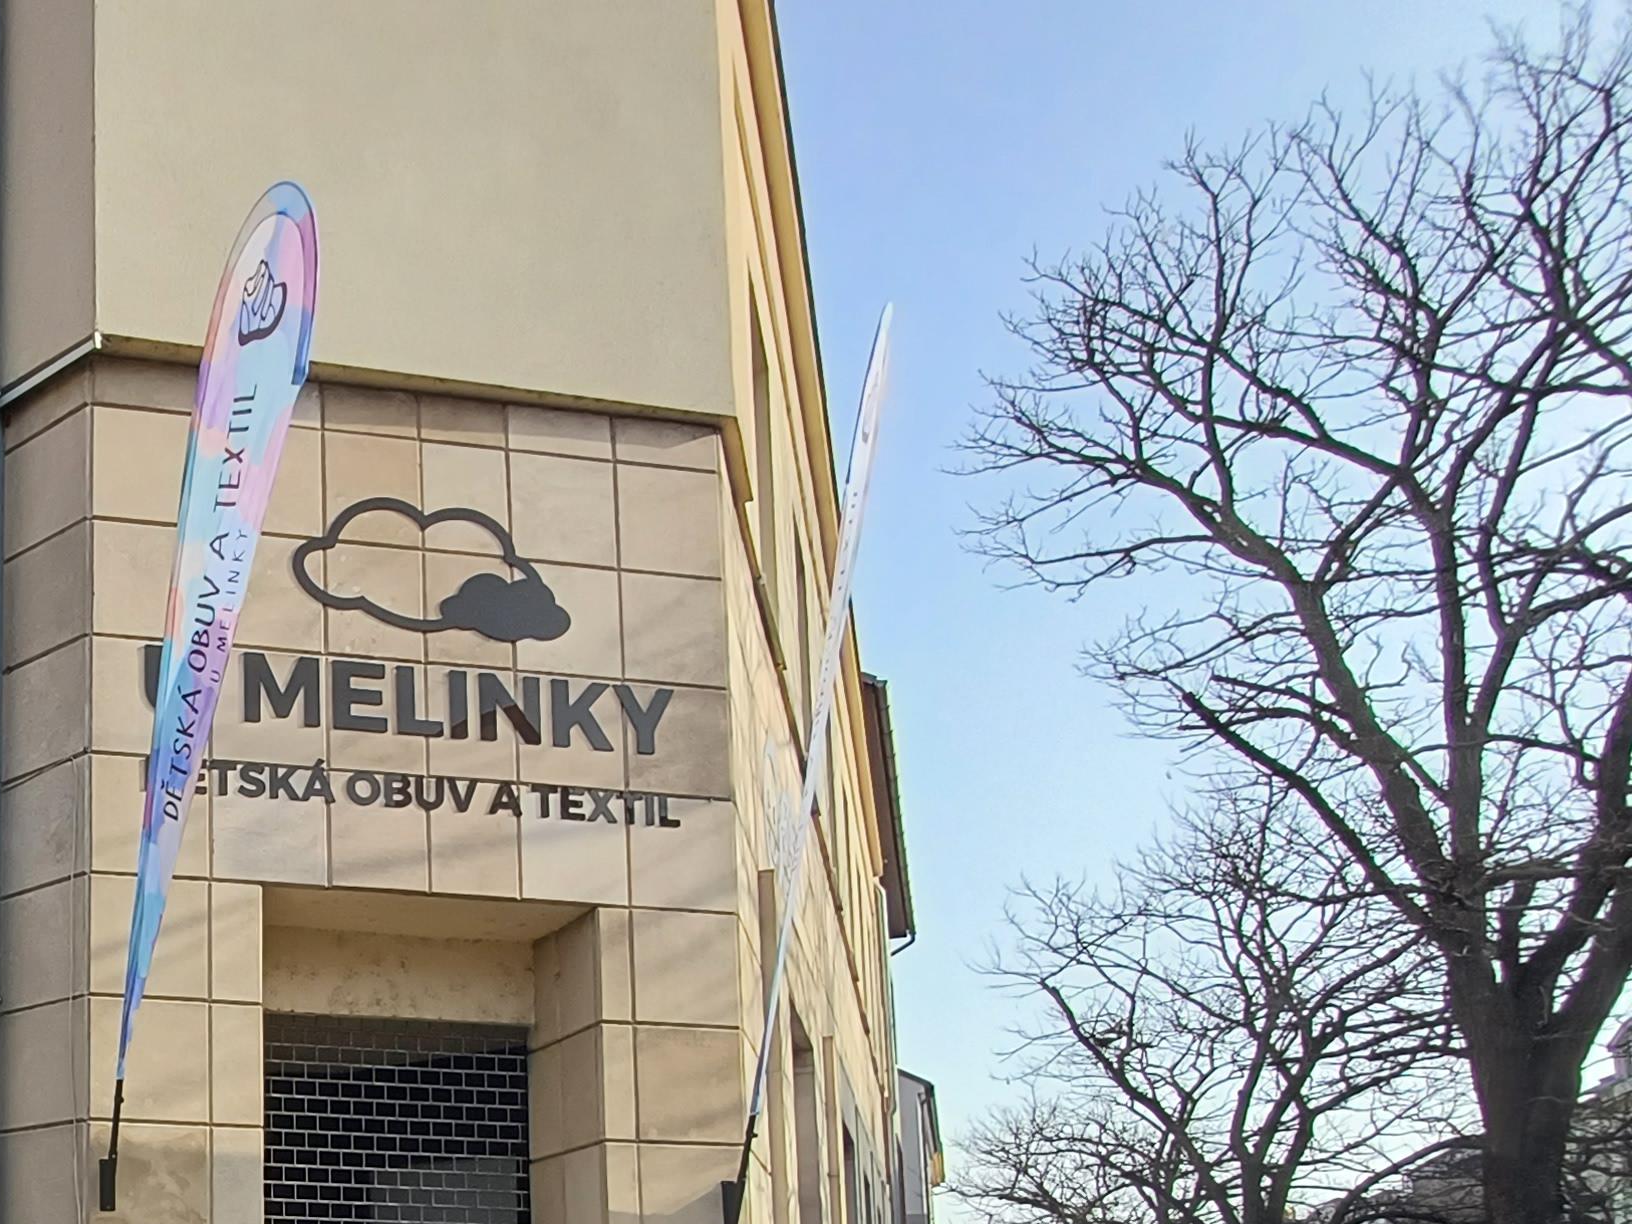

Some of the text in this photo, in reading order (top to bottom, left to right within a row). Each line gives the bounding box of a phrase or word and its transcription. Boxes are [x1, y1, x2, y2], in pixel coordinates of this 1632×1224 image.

[161, 383, 258, 822] DĚTSKÁ OBUV A TEXTIL
[210, 529, 249, 684] U MELINKY
[242, 651, 674, 756] MELINKY
[346, 771, 487, 814] OBUV
[488, 781, 522, 818] A
[526, 782, 681, 829] TEXTIL
